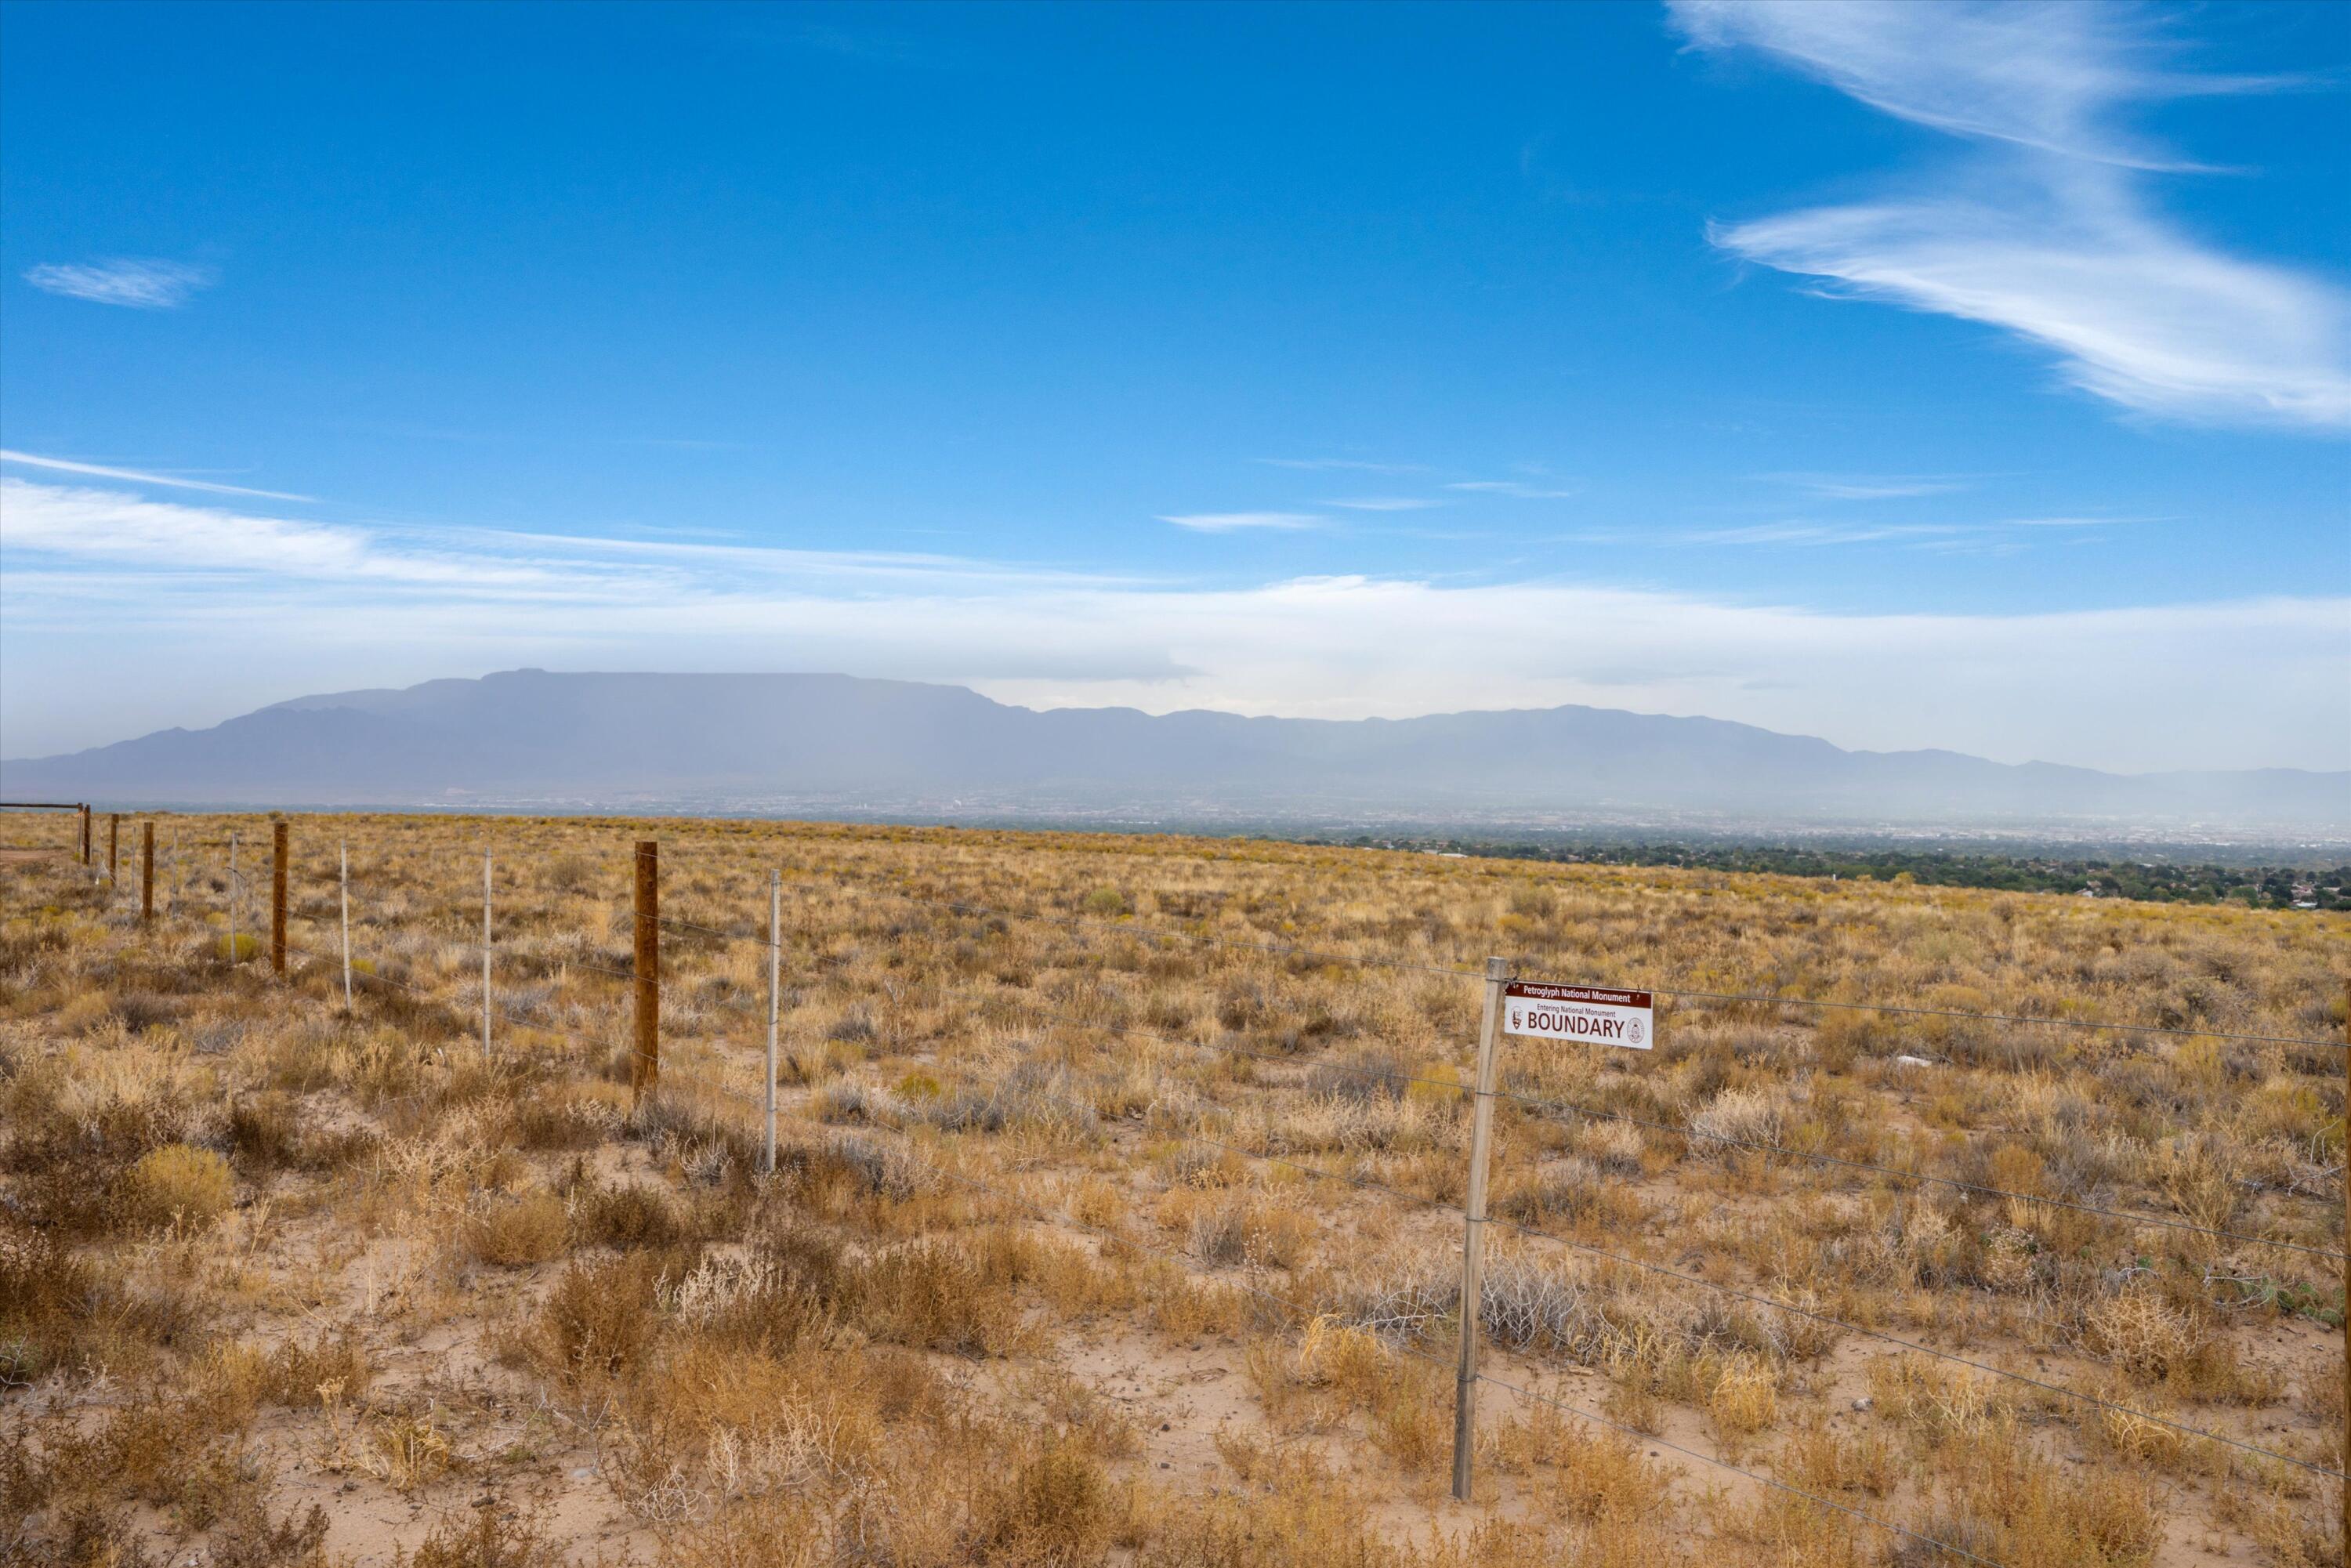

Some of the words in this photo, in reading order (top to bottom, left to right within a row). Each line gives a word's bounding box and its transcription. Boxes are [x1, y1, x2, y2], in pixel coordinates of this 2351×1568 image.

[1523, 985, 1559, 998] Petroglyph
[1561, 987, 1590, 999] National
[1592, 991, 1631, 1002] Monument
[1537, 1003, 1559, 1014] Entering
[1560, 1005, 1584, 1015] National
[1585, 1008, 1616, 1018] Monument
[1528, 1012, 1625, 1038] BOUNDARY
